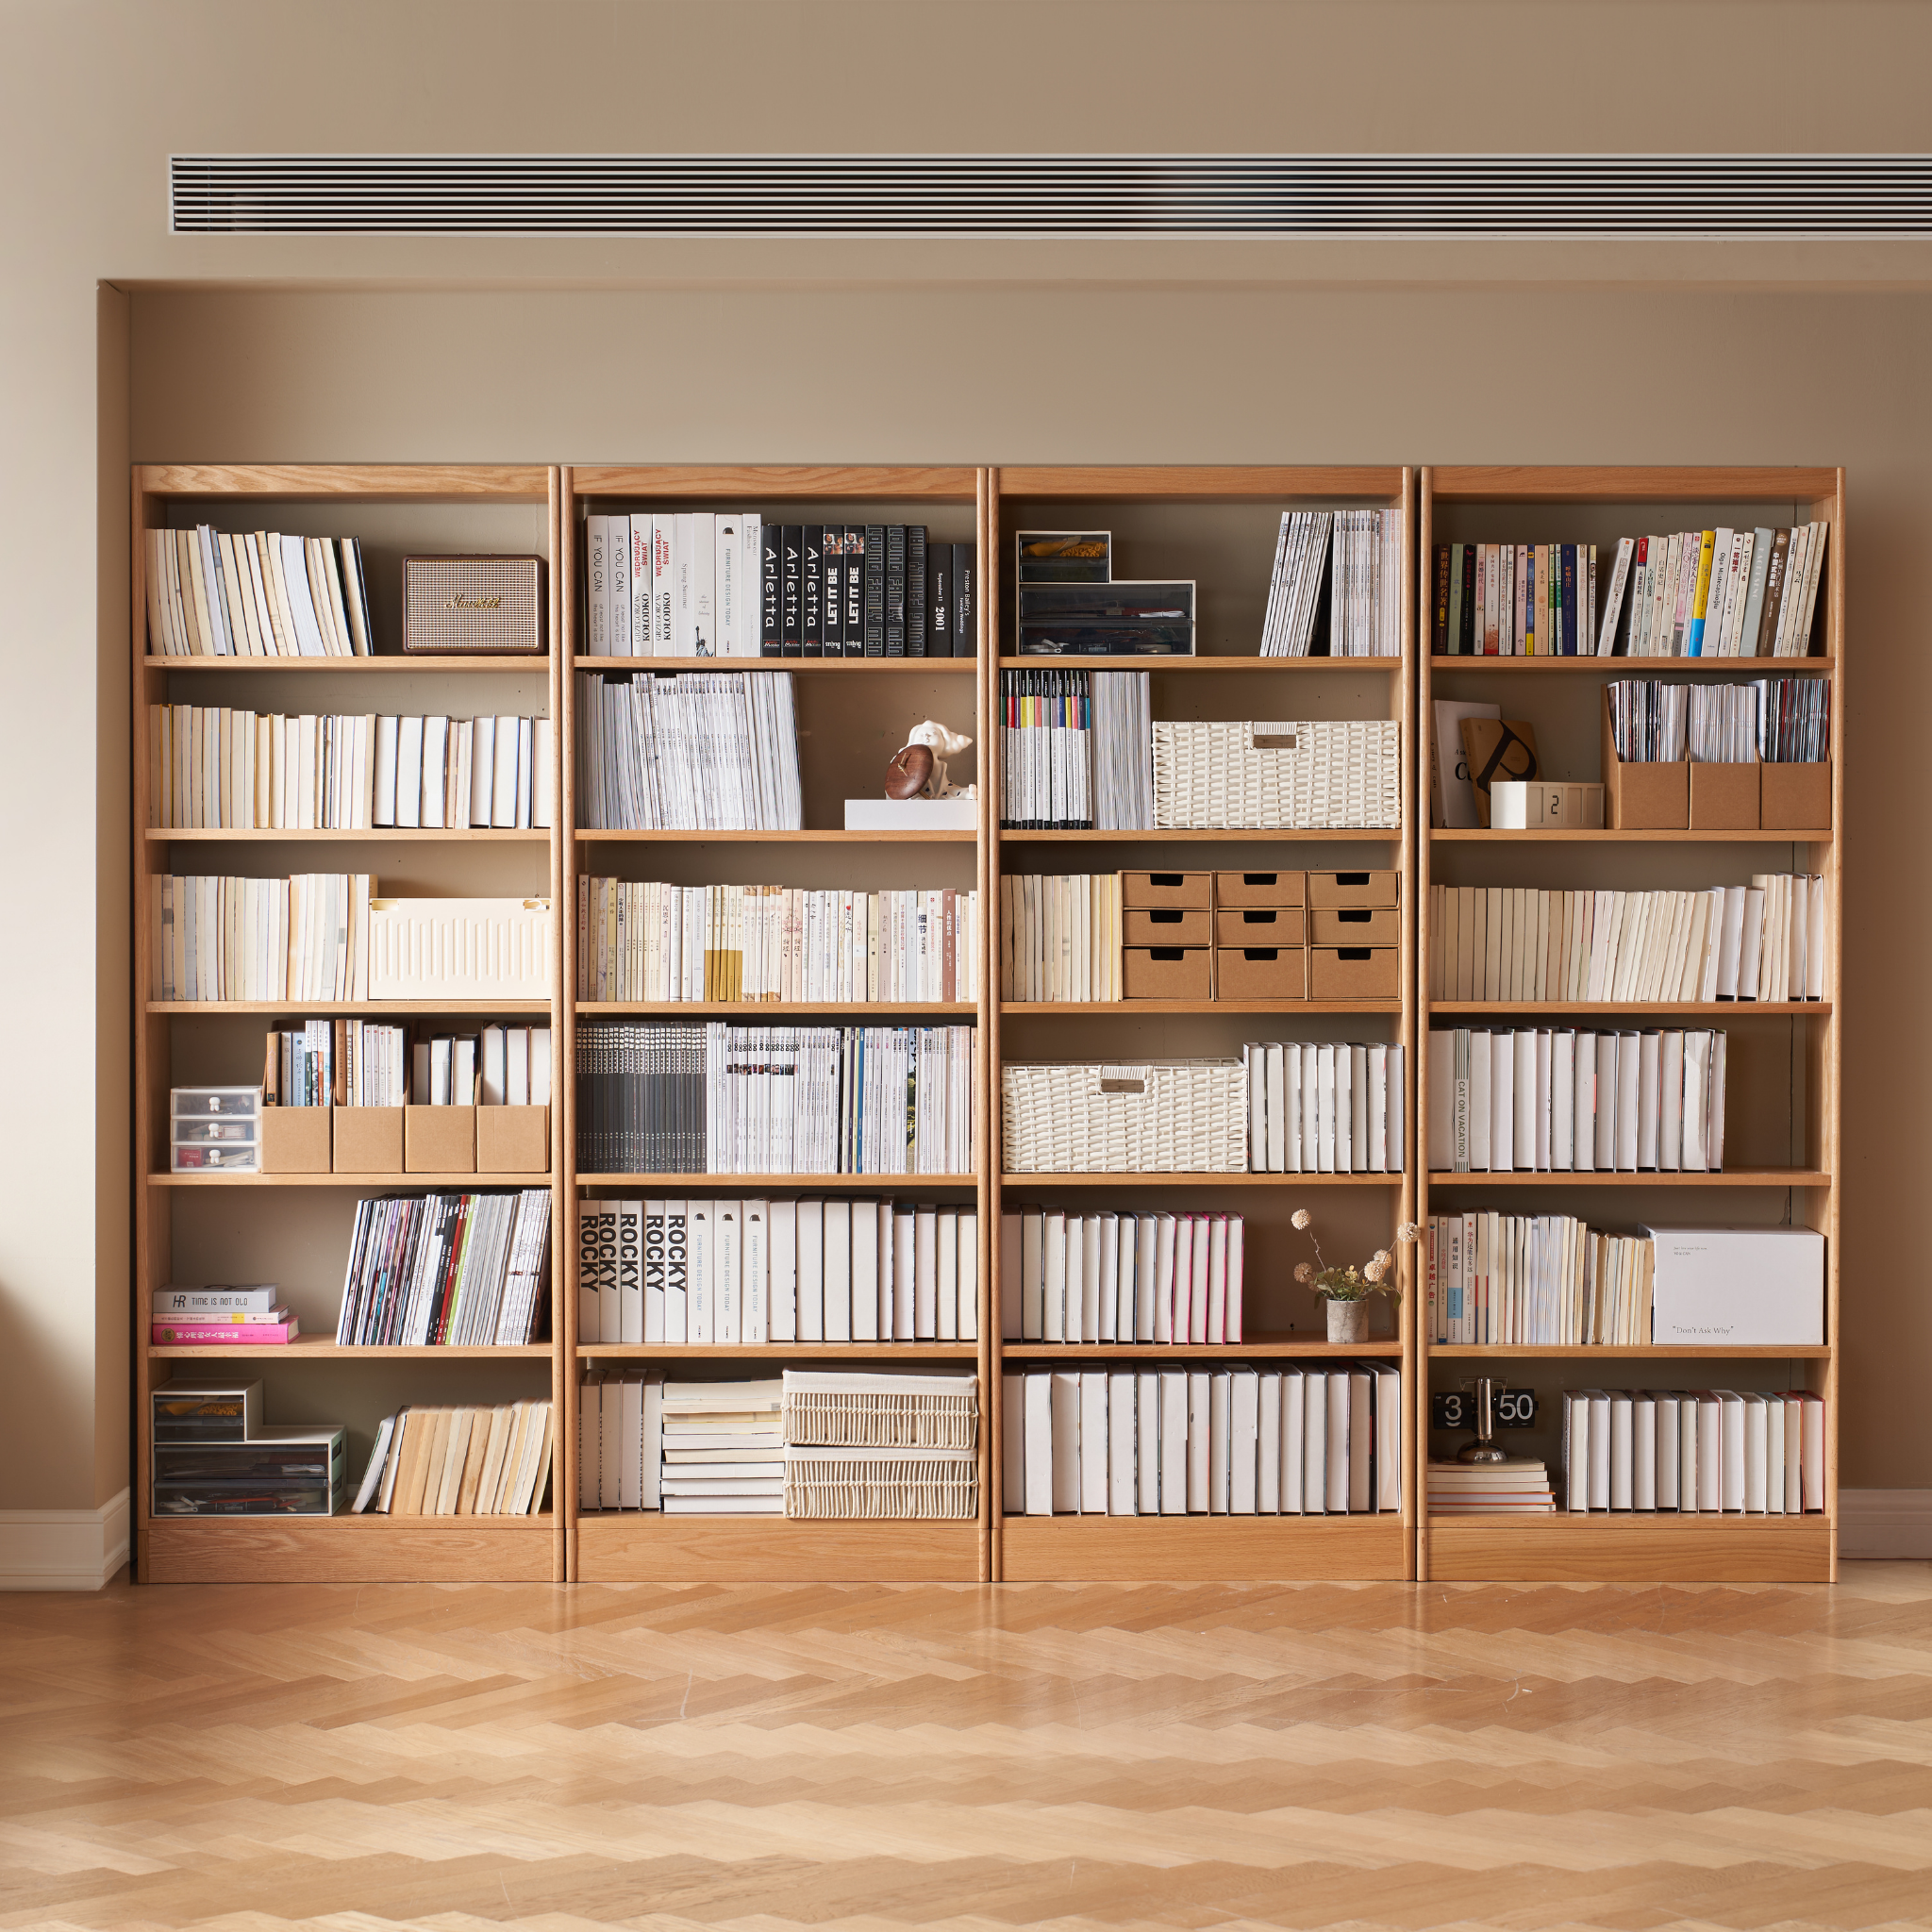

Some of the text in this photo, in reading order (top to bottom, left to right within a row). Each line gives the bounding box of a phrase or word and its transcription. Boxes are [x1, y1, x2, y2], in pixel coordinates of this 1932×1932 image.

[615, 548, 624, 568] YOU
[615, 572, 624, 592] CAN
[1440, 552, 1448, 606] 世界传世名著
[766, 547, 778, 627] Arletta
[787, 547, 799, 626] Arletta
[808, 547, 820, 626] Arletta
[828, 568, 838, 625] LET IT BE
[849, 567, 858, 625] LET IT BE
[641, 593, 650, 641] KOŁODKO
[936, 607, 944, 631] 2001
[1551, 795, 1558, 814] 2
[918, 914, 926, 934] 细节
[1458, 1100, 1465, 1112] ON
[581, 1216, 598, 1292] ROCKY
[600, 1213, 616, 1291] ROCKY
[621, 1214, 638, 1291] ROCKY
[646, 1215, 664, 1292] ROCKY
[669, 1215, 686, 1292] ROCKY
[173, 1295, 187, 1307] HR
[192, 1297, 208, 1306] TIME
[211, 1297, 217, 1306] IS
[220, 1297, 232, 1306] NOT
[1445, 1394, 1533, 1420] 3 50
